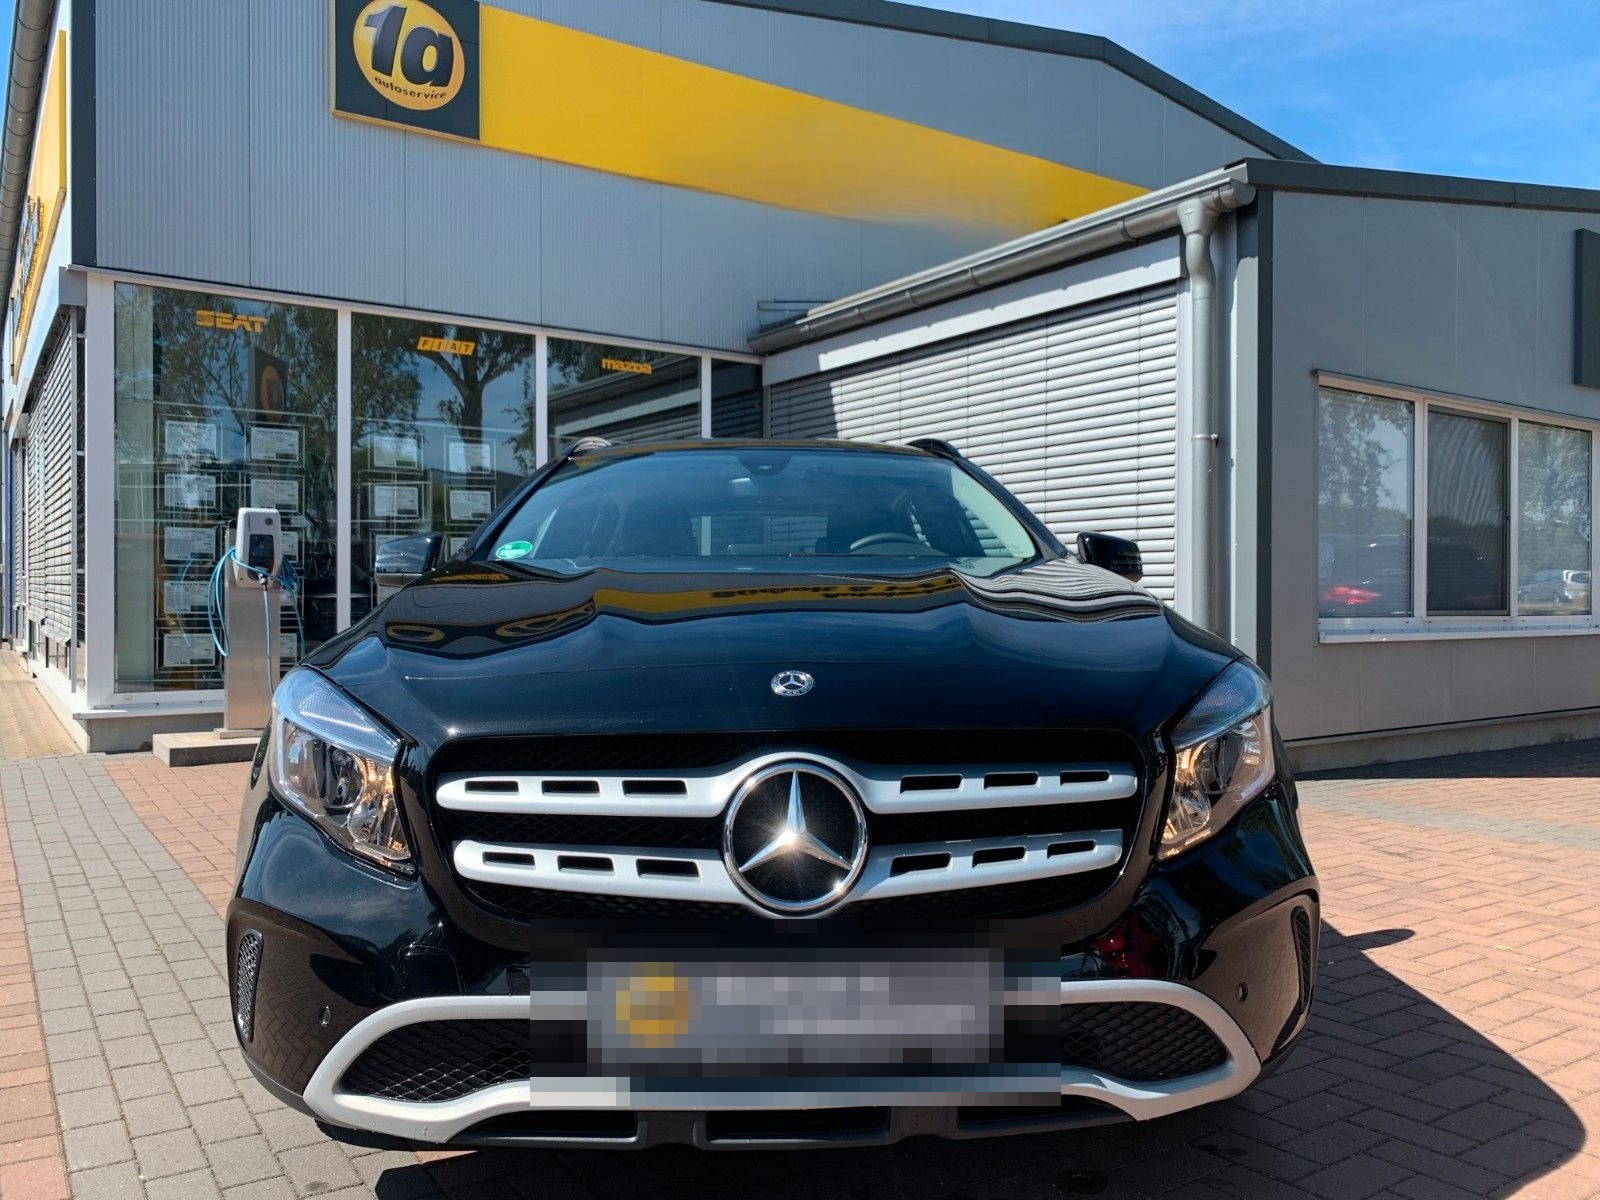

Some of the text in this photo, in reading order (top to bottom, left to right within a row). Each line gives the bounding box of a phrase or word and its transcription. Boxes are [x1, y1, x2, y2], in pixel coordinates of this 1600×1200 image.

[364, 5, 454, 87] 1a
[374, 76, 447, 100] autoservice
[196, 310, 267, 333] SEAT
[419, 337, 474, 355] FIAT
